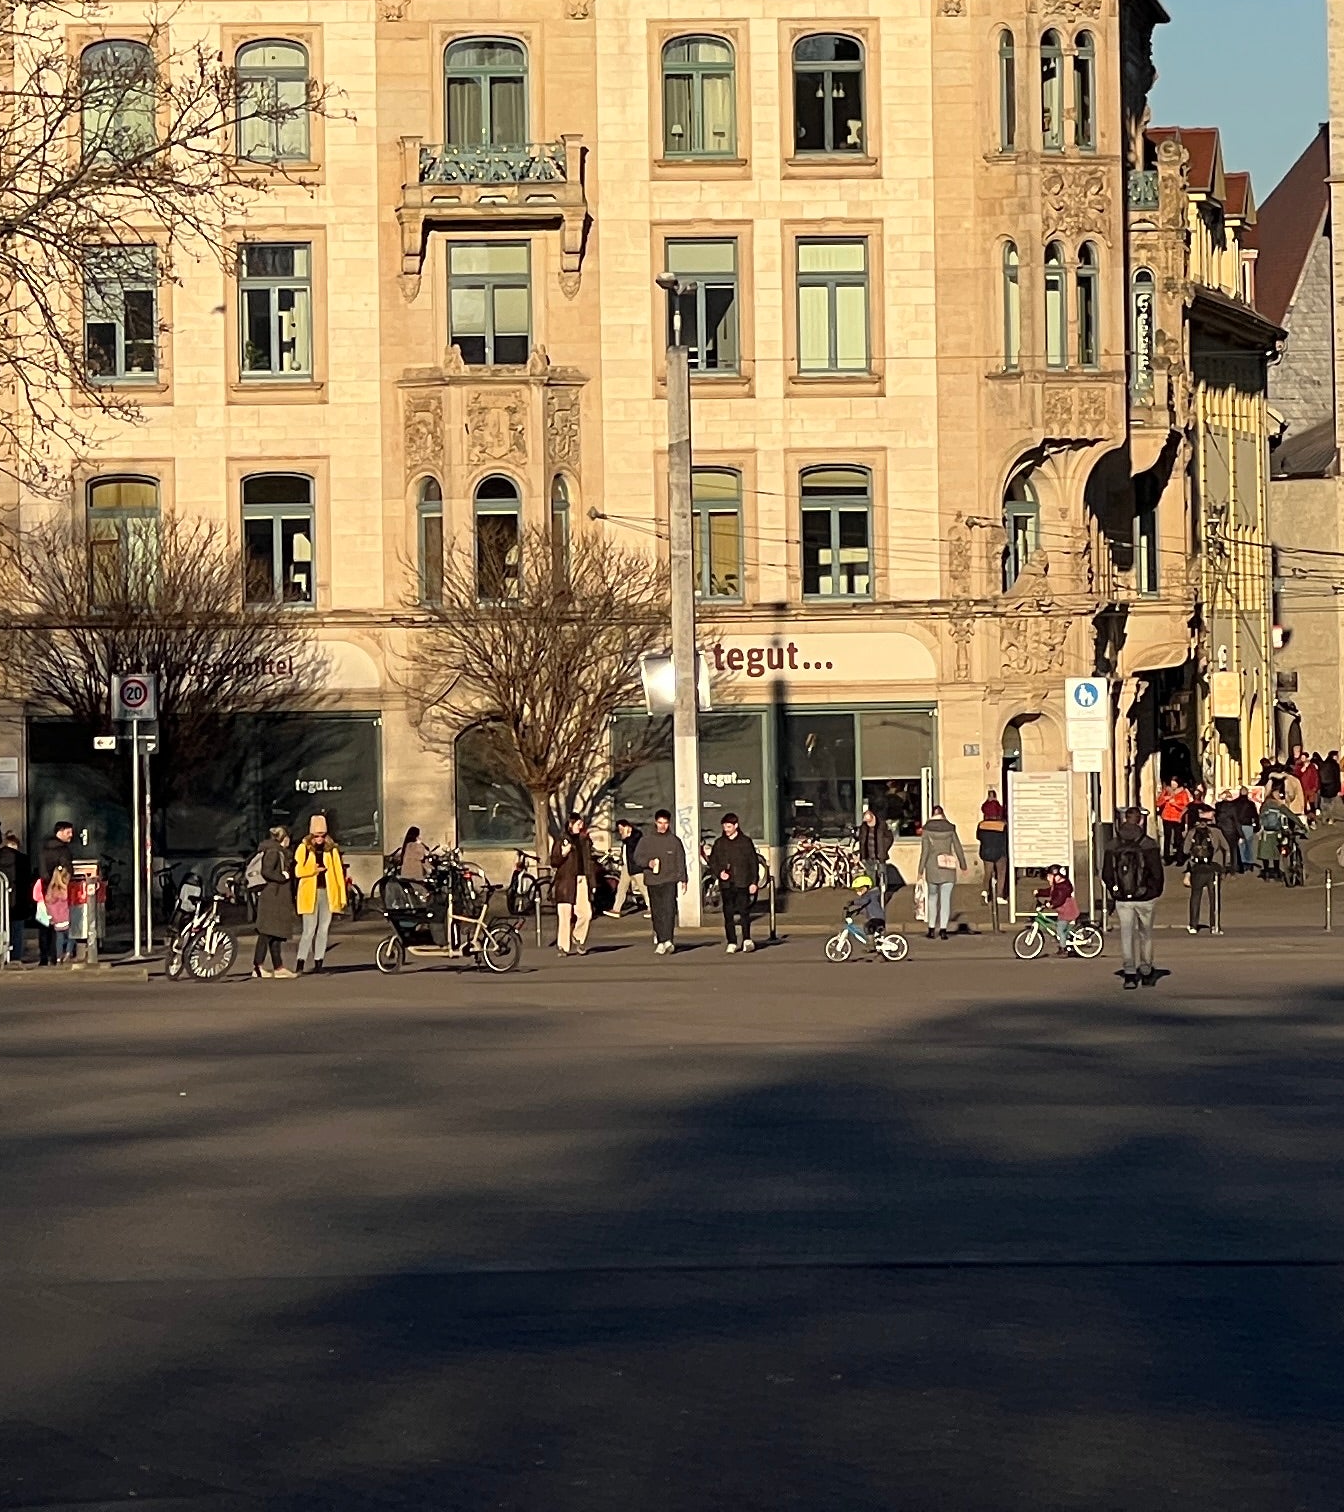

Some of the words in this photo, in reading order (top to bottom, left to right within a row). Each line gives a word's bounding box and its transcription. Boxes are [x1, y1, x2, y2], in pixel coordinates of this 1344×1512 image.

[713, 642, 833, 677] tegut...
[126, 686, 142, 700] 20
[295, 779, 343, 794] tegut...
[704, 772, 751, 787] tegut...
